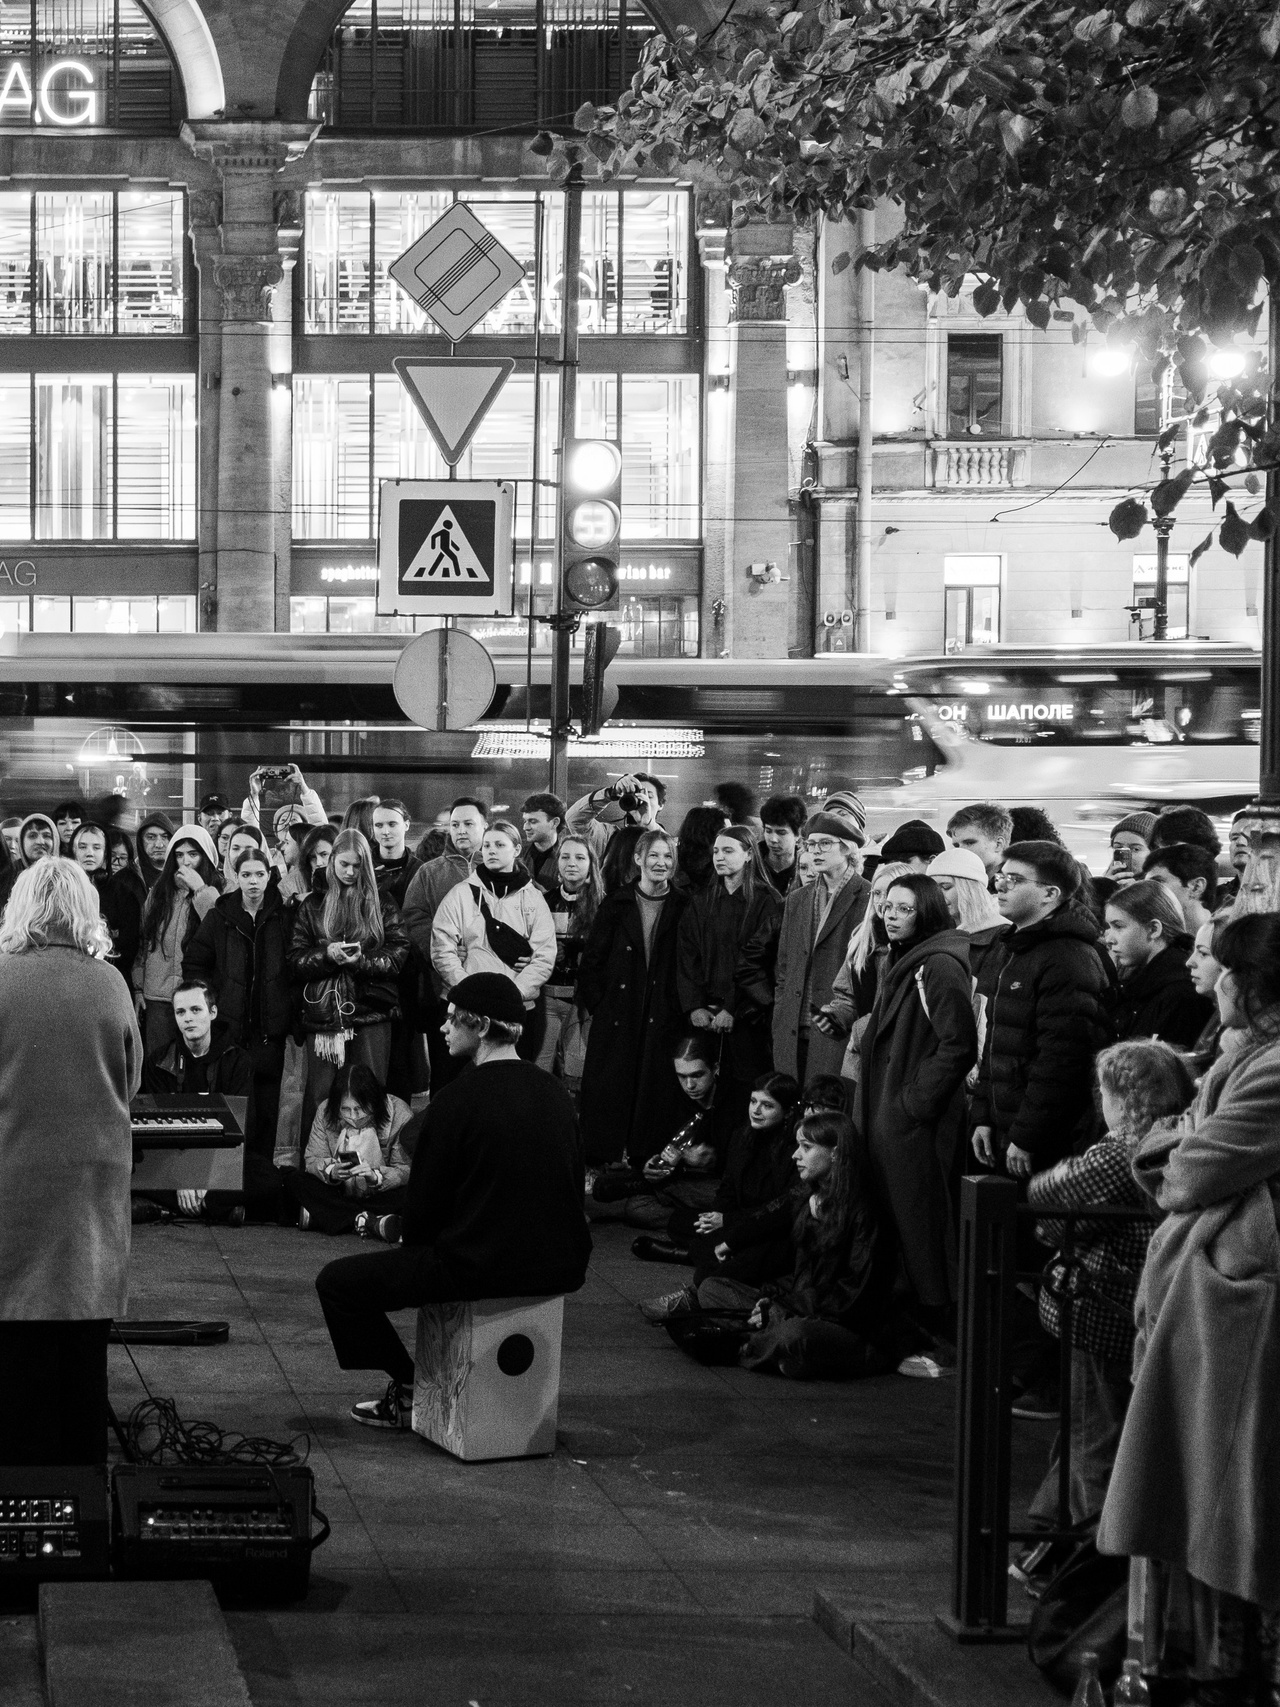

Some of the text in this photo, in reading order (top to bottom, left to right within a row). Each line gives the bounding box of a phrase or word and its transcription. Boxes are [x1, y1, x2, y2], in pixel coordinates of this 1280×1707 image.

[649, 565, 671, 580] bar
[987, 704, 1074, 720] ШАПОЛЕ
[245, 1546, 288, 1559] Roland
